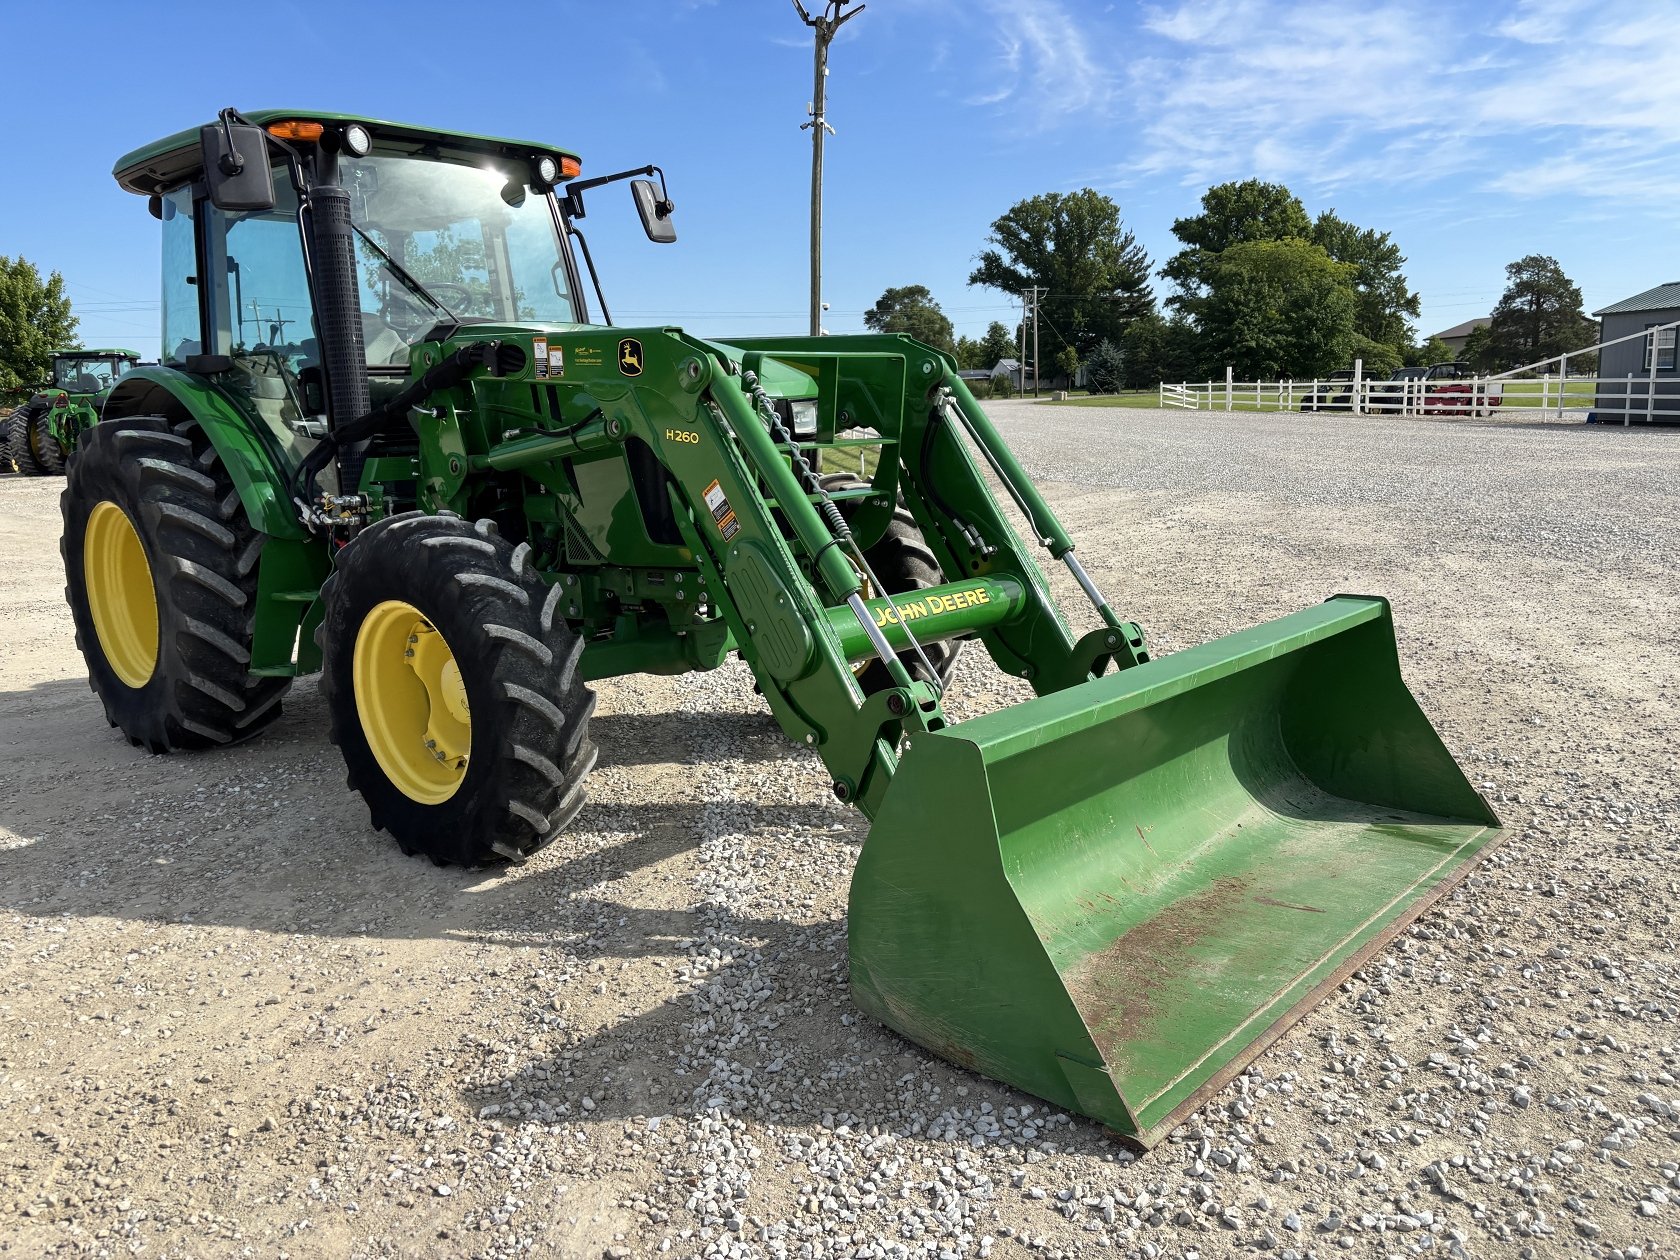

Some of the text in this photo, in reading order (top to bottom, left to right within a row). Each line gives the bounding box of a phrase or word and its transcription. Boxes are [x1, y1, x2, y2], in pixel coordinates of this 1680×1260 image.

[666, 428, 699, 444] H260
[875, 588, 990, 627] JOHN DEERE
